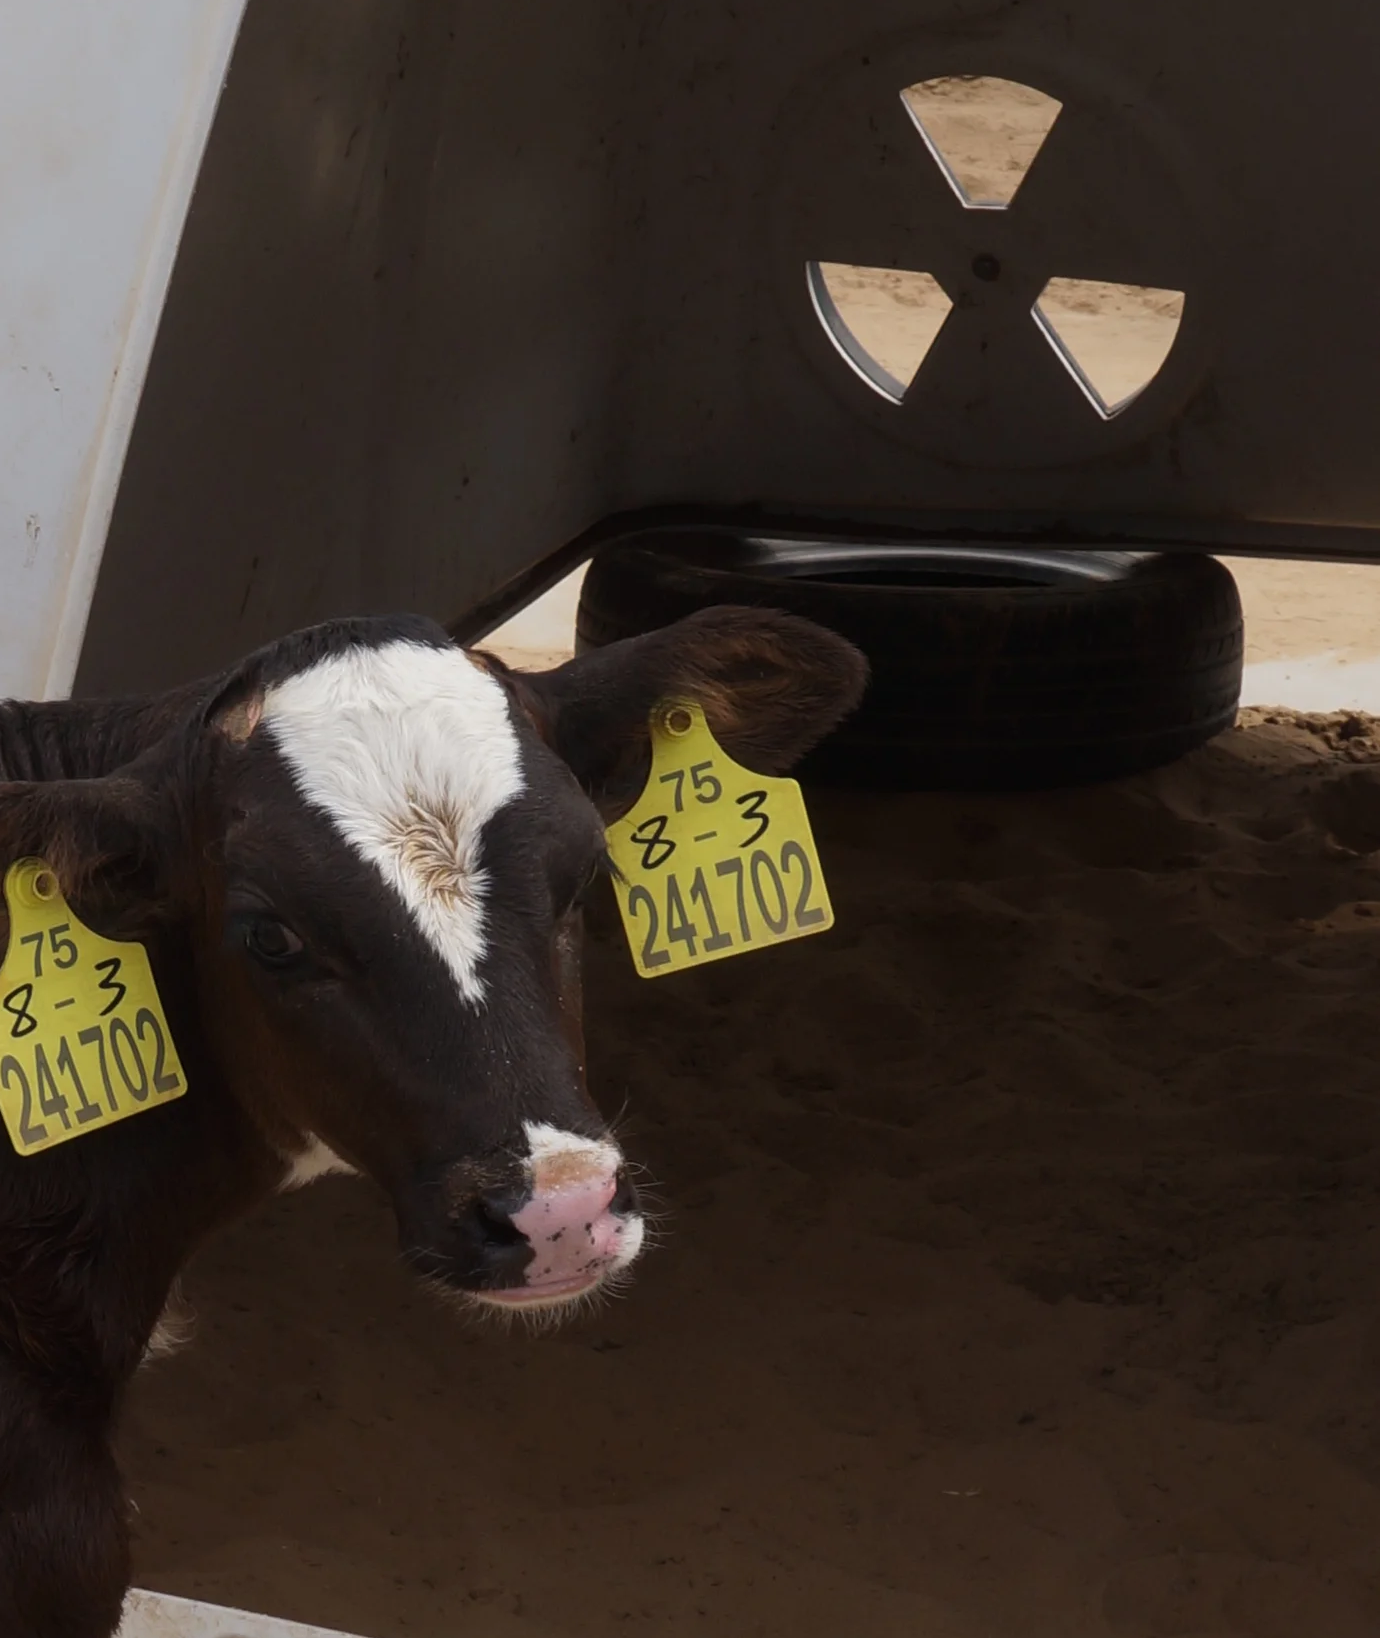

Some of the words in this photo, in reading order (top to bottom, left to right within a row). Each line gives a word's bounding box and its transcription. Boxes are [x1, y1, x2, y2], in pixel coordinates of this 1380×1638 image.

[658, 760, 723, 813] 75
[20, 923, 78, 978] 75
[628, 840, 825, 969] 241702
[0, 1007, 181, 1146] 241702
